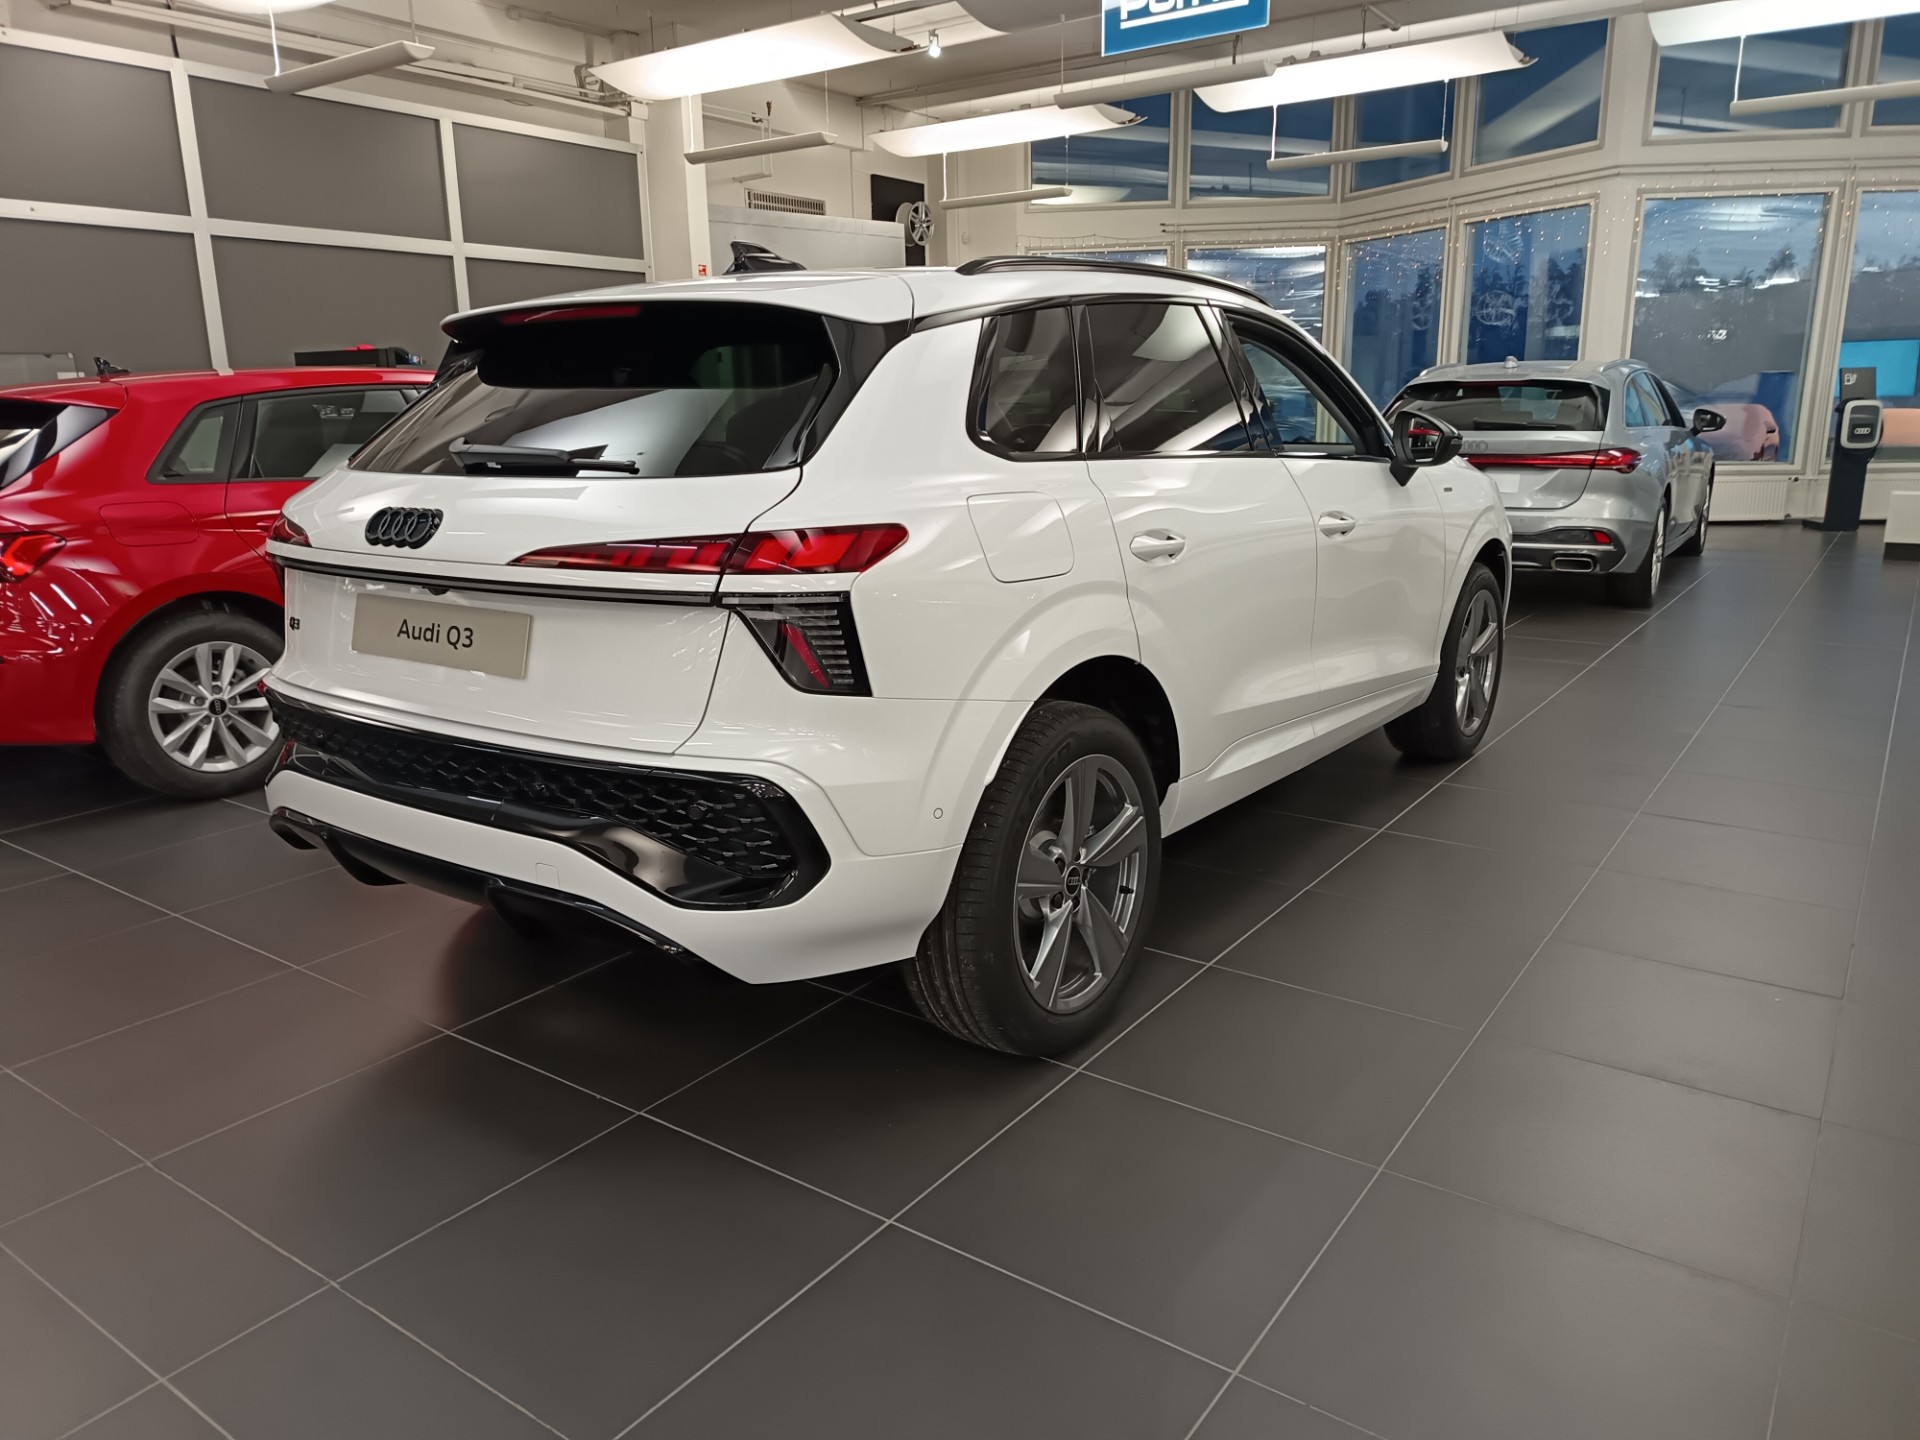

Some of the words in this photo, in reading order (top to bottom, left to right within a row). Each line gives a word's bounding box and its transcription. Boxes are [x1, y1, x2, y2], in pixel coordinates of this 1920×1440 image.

[289, 616, 300, 631] Q3
[397, 618, 441, 643] Audi
[446, 625, 474, 650] Q3
